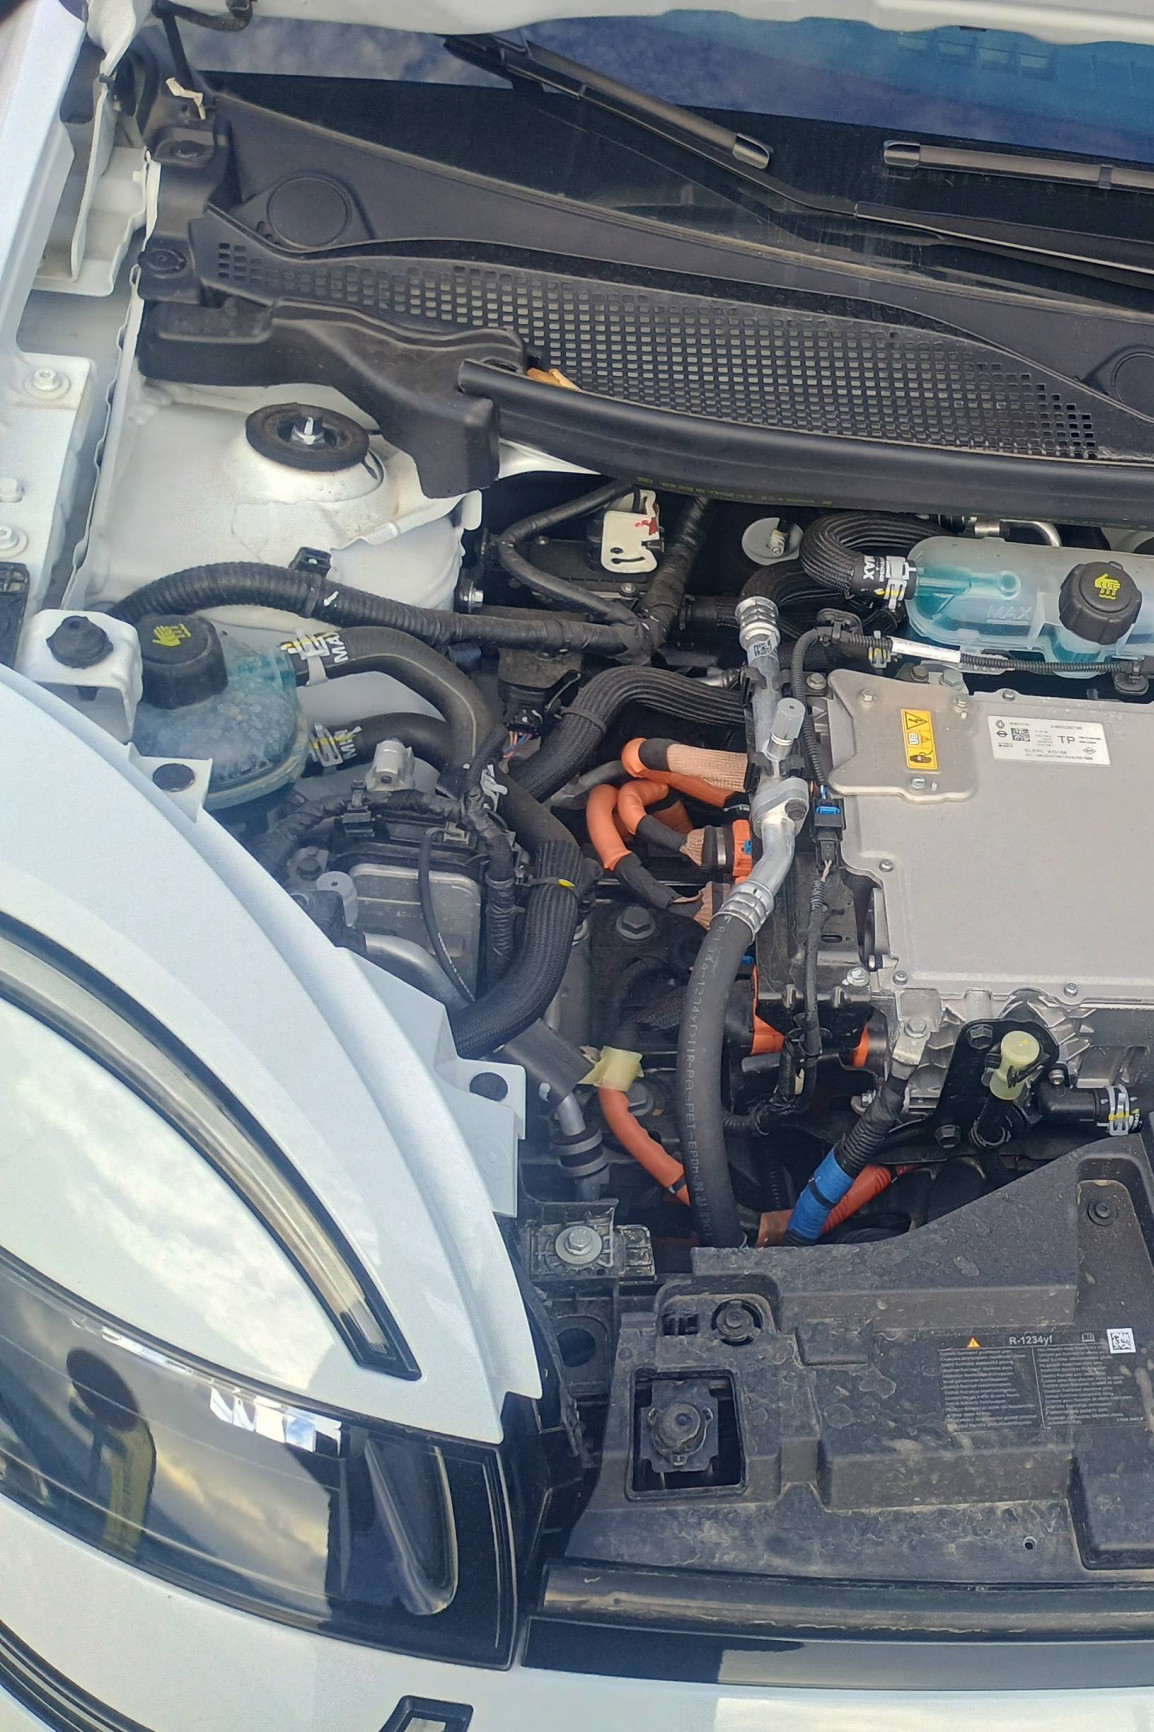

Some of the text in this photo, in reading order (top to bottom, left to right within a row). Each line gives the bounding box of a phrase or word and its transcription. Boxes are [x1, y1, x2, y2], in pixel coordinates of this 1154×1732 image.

[863, 555, 875, 580] MAX
[987, 604, 1032, 620] MAX
[1057, 736, 1076, 744] TP
[1009, 1335, 1053, 1346] R-1234yf
